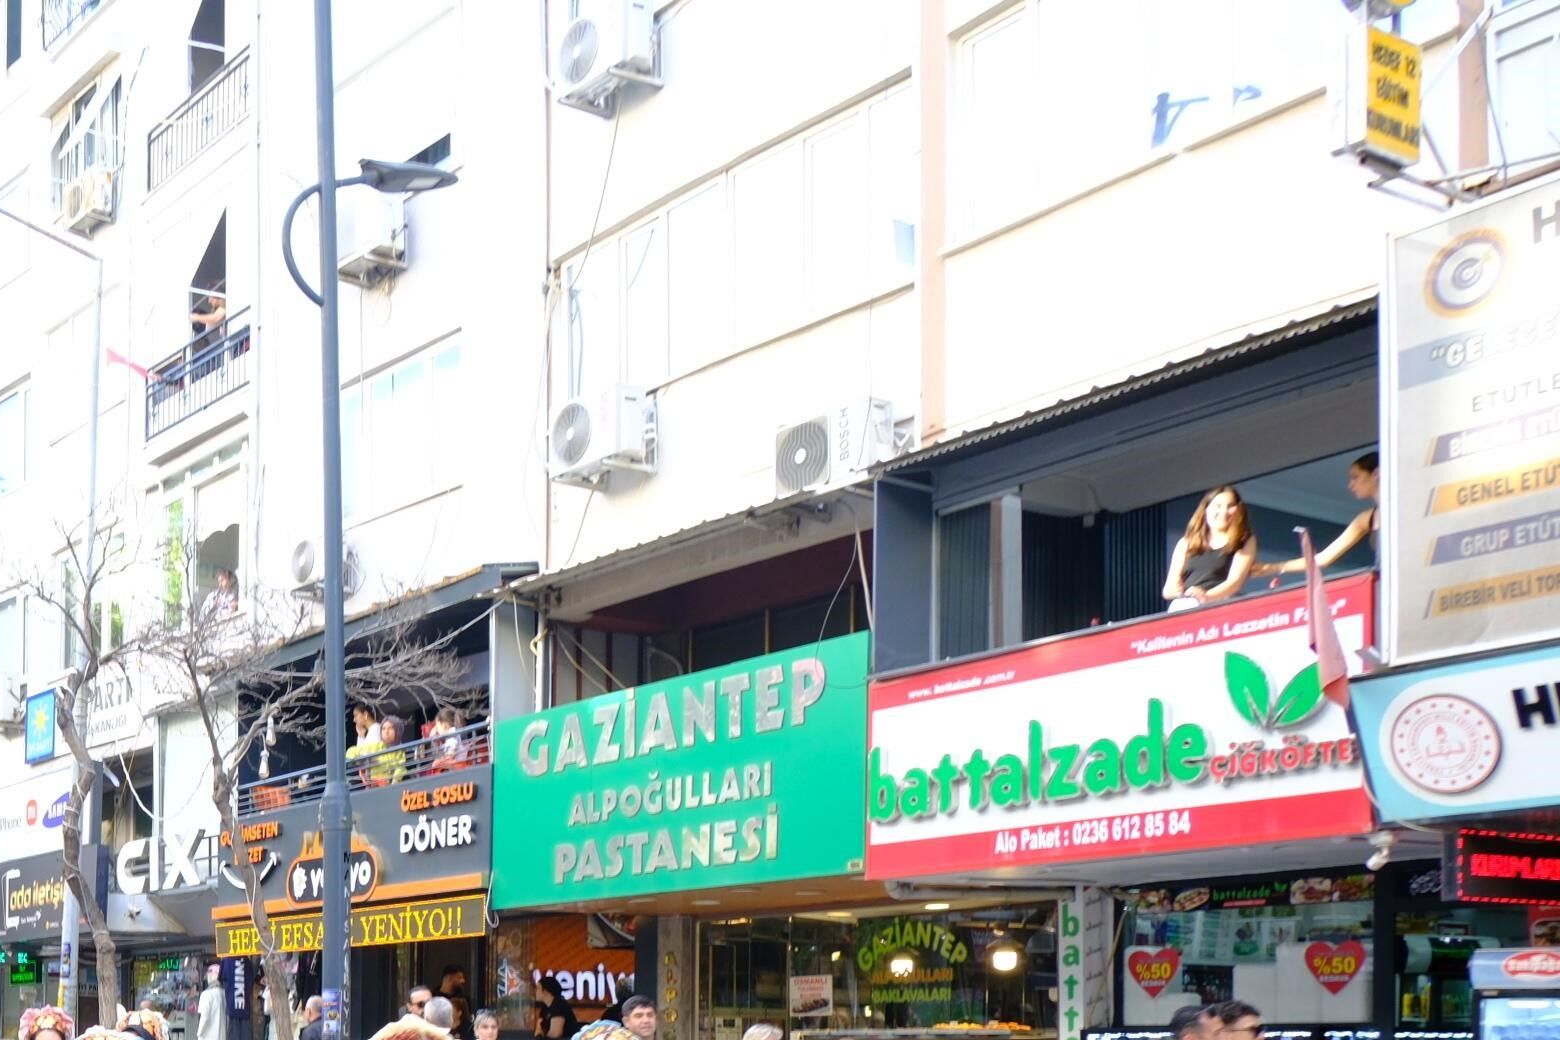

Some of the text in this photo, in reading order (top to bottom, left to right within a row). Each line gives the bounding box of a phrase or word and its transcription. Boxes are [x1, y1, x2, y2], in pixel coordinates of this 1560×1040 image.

[839, 406, 850, 462] BOSCH
[1456, 476, 1515, 507] GENEL
[1460, 528, 1510, 557] GRUP
[1440, 576, 1497, 613] BİREBİR
[1501, 572, 1534, 601] VELİ
[1222, 612, 1290, 638] Lezzetin
[518, 657, 827, 778] GAZİANTEP
[868, 697, 1208, 823] battalzade
[1208, 733, 1358, 783] ÇİĞKÖFTE
[401, 782, 475, 812] ÖZEL SOSLU
[567, 760, 773, 828] ALPOĞULLARI
[399, 814, 473, 854] DÖNER
[554, 802, 779, 886] PASTANESİ
[995, 831, 1018, 854] Alo
[1020, 823, 1061, 851] Paket
[1072, 819, 1109, 846] 0236
[1112, 814, 1141, 840] 612
[1144, 811, 1167, 837] 85
[1169, 809, 1191, 835] 84
[31, 874, 64, 911] iletişi
[360, 904, 462, 945] YENİYO!!
[856, 915, 969, 973] GAZİANTEP
[1135, 961, 1172, 980] %50
[1313, 955, 1356, 976] %50
[871, 986, 953, 1004] BAKLAVALARI
